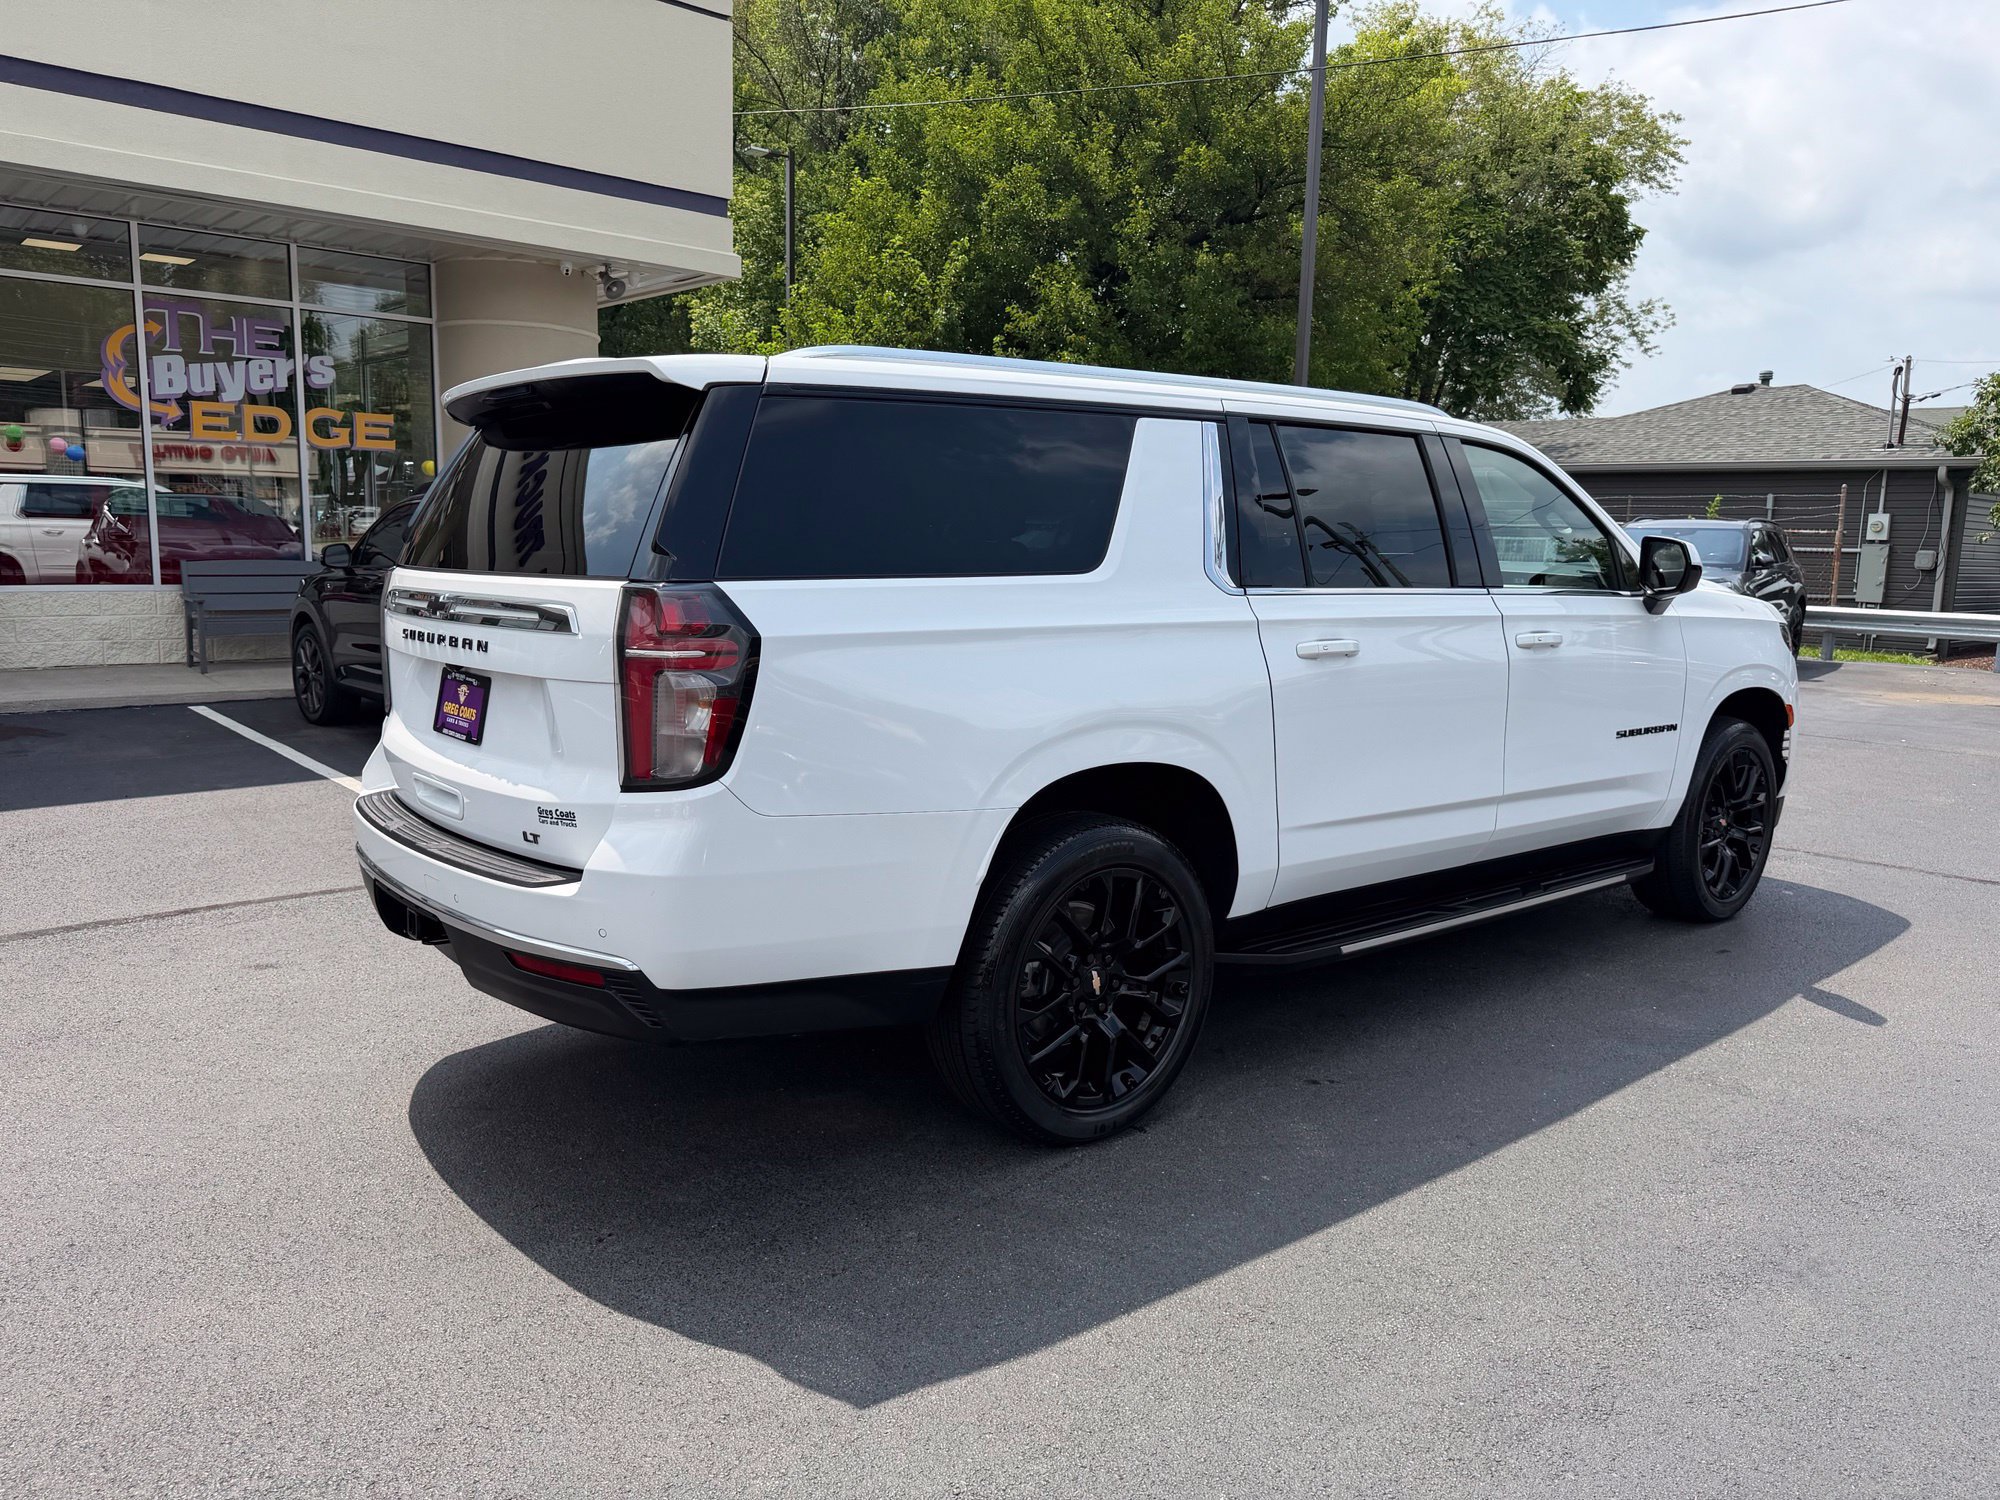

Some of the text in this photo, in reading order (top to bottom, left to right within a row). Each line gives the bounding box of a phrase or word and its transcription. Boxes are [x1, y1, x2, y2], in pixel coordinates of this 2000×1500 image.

[143, 300, 286, 359] THE
[189, 400, 397, 451] EDGE
[402, 628, 489, 653] SUBURBAN
[443, 701, 477, 721] GREG COATS
[1616, 723, 1678, 739] SUBURBAN
[537, 806, 576, 819] Greg Coats
[560, 820, 578, 828] Trucks
[522, 831, 540, 844] LT
